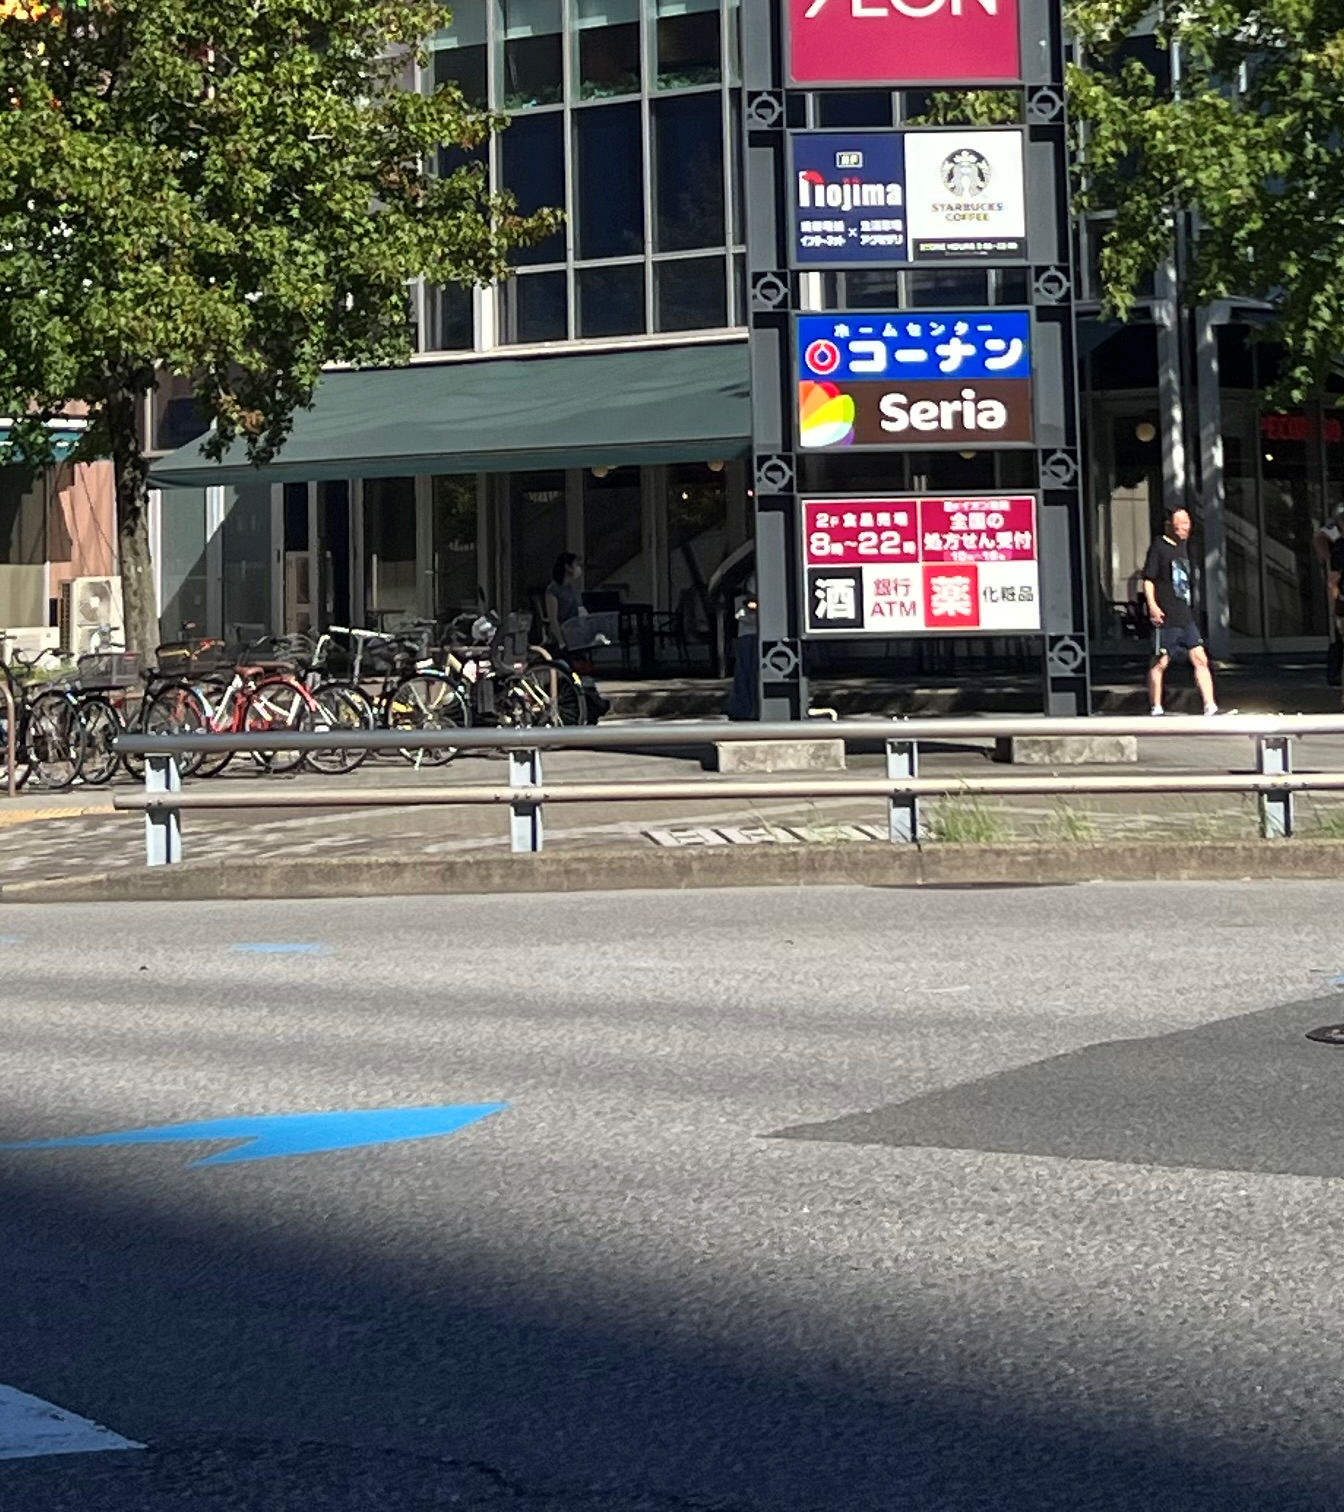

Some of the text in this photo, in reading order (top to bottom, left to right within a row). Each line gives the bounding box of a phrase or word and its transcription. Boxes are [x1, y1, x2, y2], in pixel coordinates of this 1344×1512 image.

[931, 202, 1004, 212] STARBUCKS
[945, 213, 990, 222] COFFEE
[834, 321, 993, 338] ホームセンター
[848, 337, 1023, 373] コーナン
[879, 388, 1007, 432] Seria
[873, 578, 911, 598] 銀行
[930, 576, 972, 617] 薬
[983, 585, 1034, 603] 化粧品
[815, 578, 855, 620] 酒
[870, 600, 917, 618] ATM
